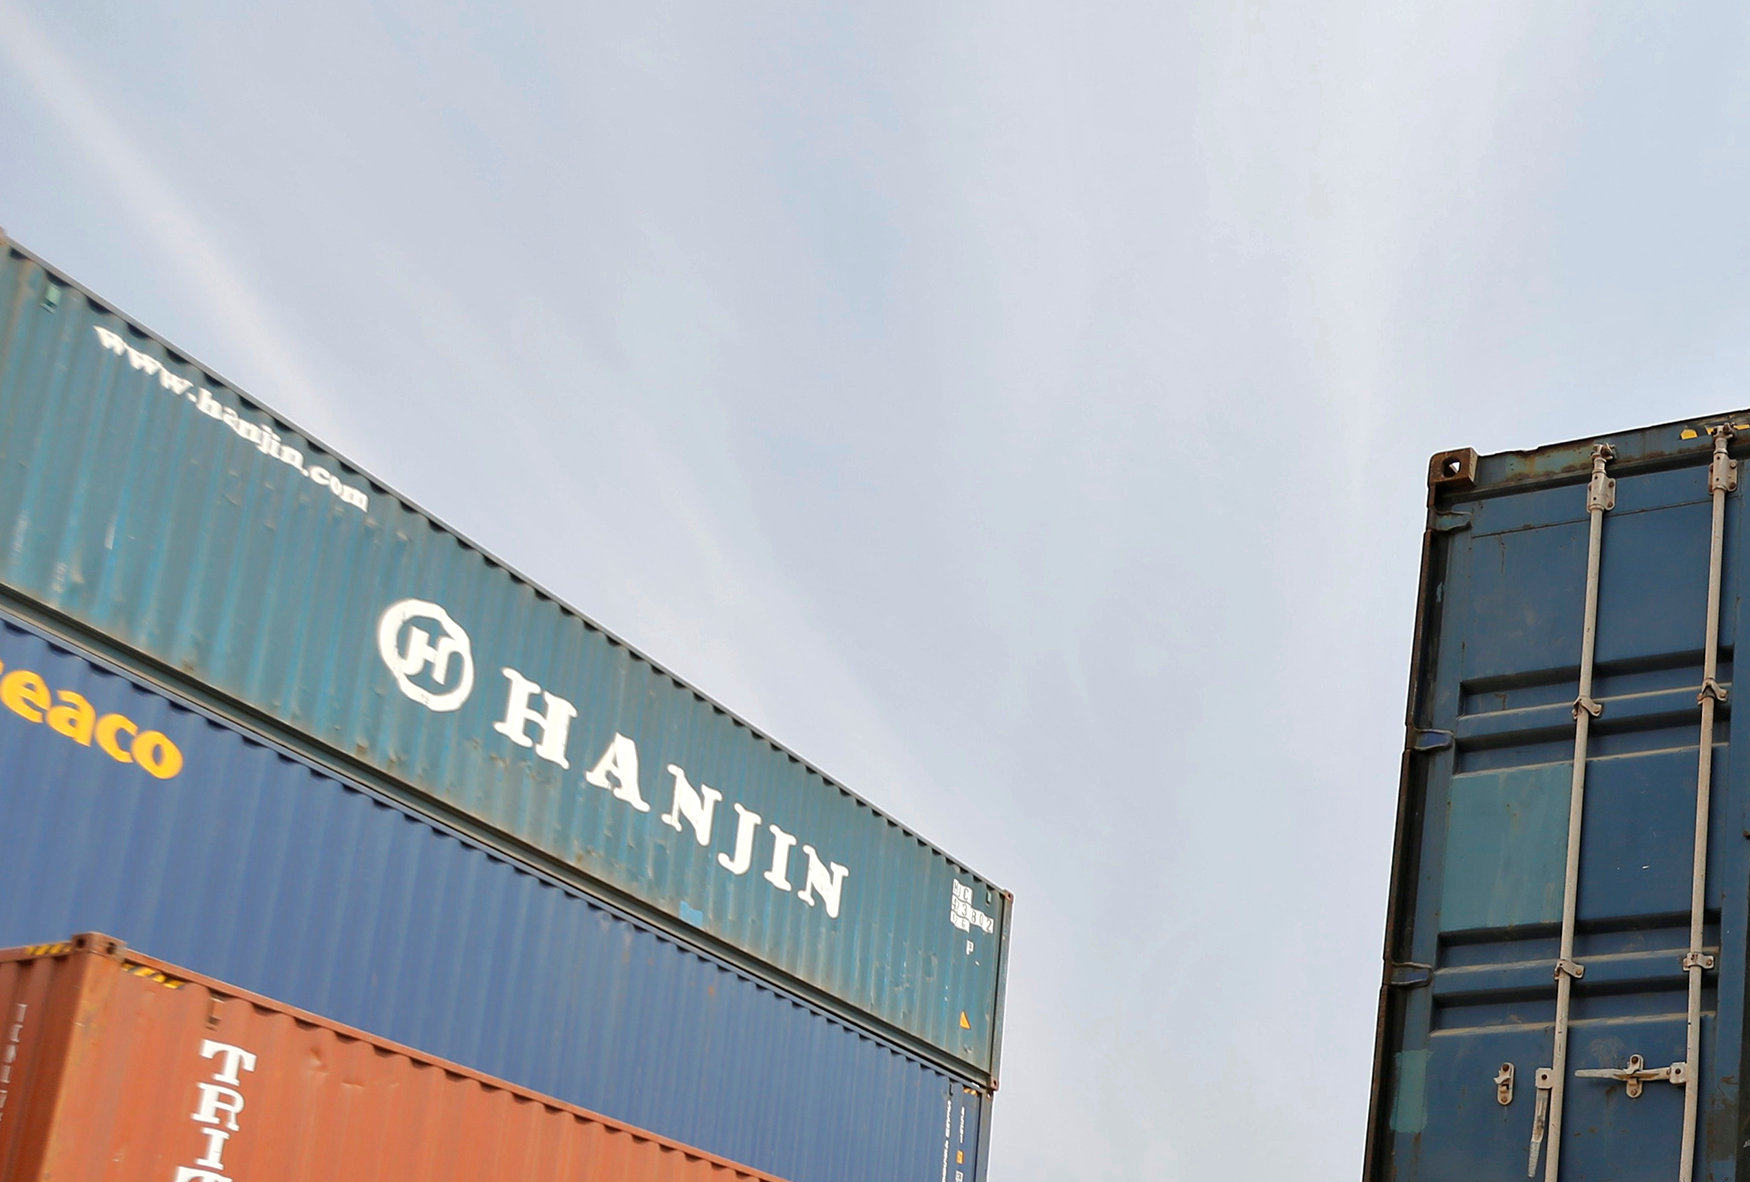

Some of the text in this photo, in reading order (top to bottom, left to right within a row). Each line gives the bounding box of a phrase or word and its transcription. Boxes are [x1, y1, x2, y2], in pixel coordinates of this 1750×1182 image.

[94, 325, 369, 513] www.hanjin.com
[0, 660, 183, 780] eaco
[494, 667, 849, 918] HANJIN
